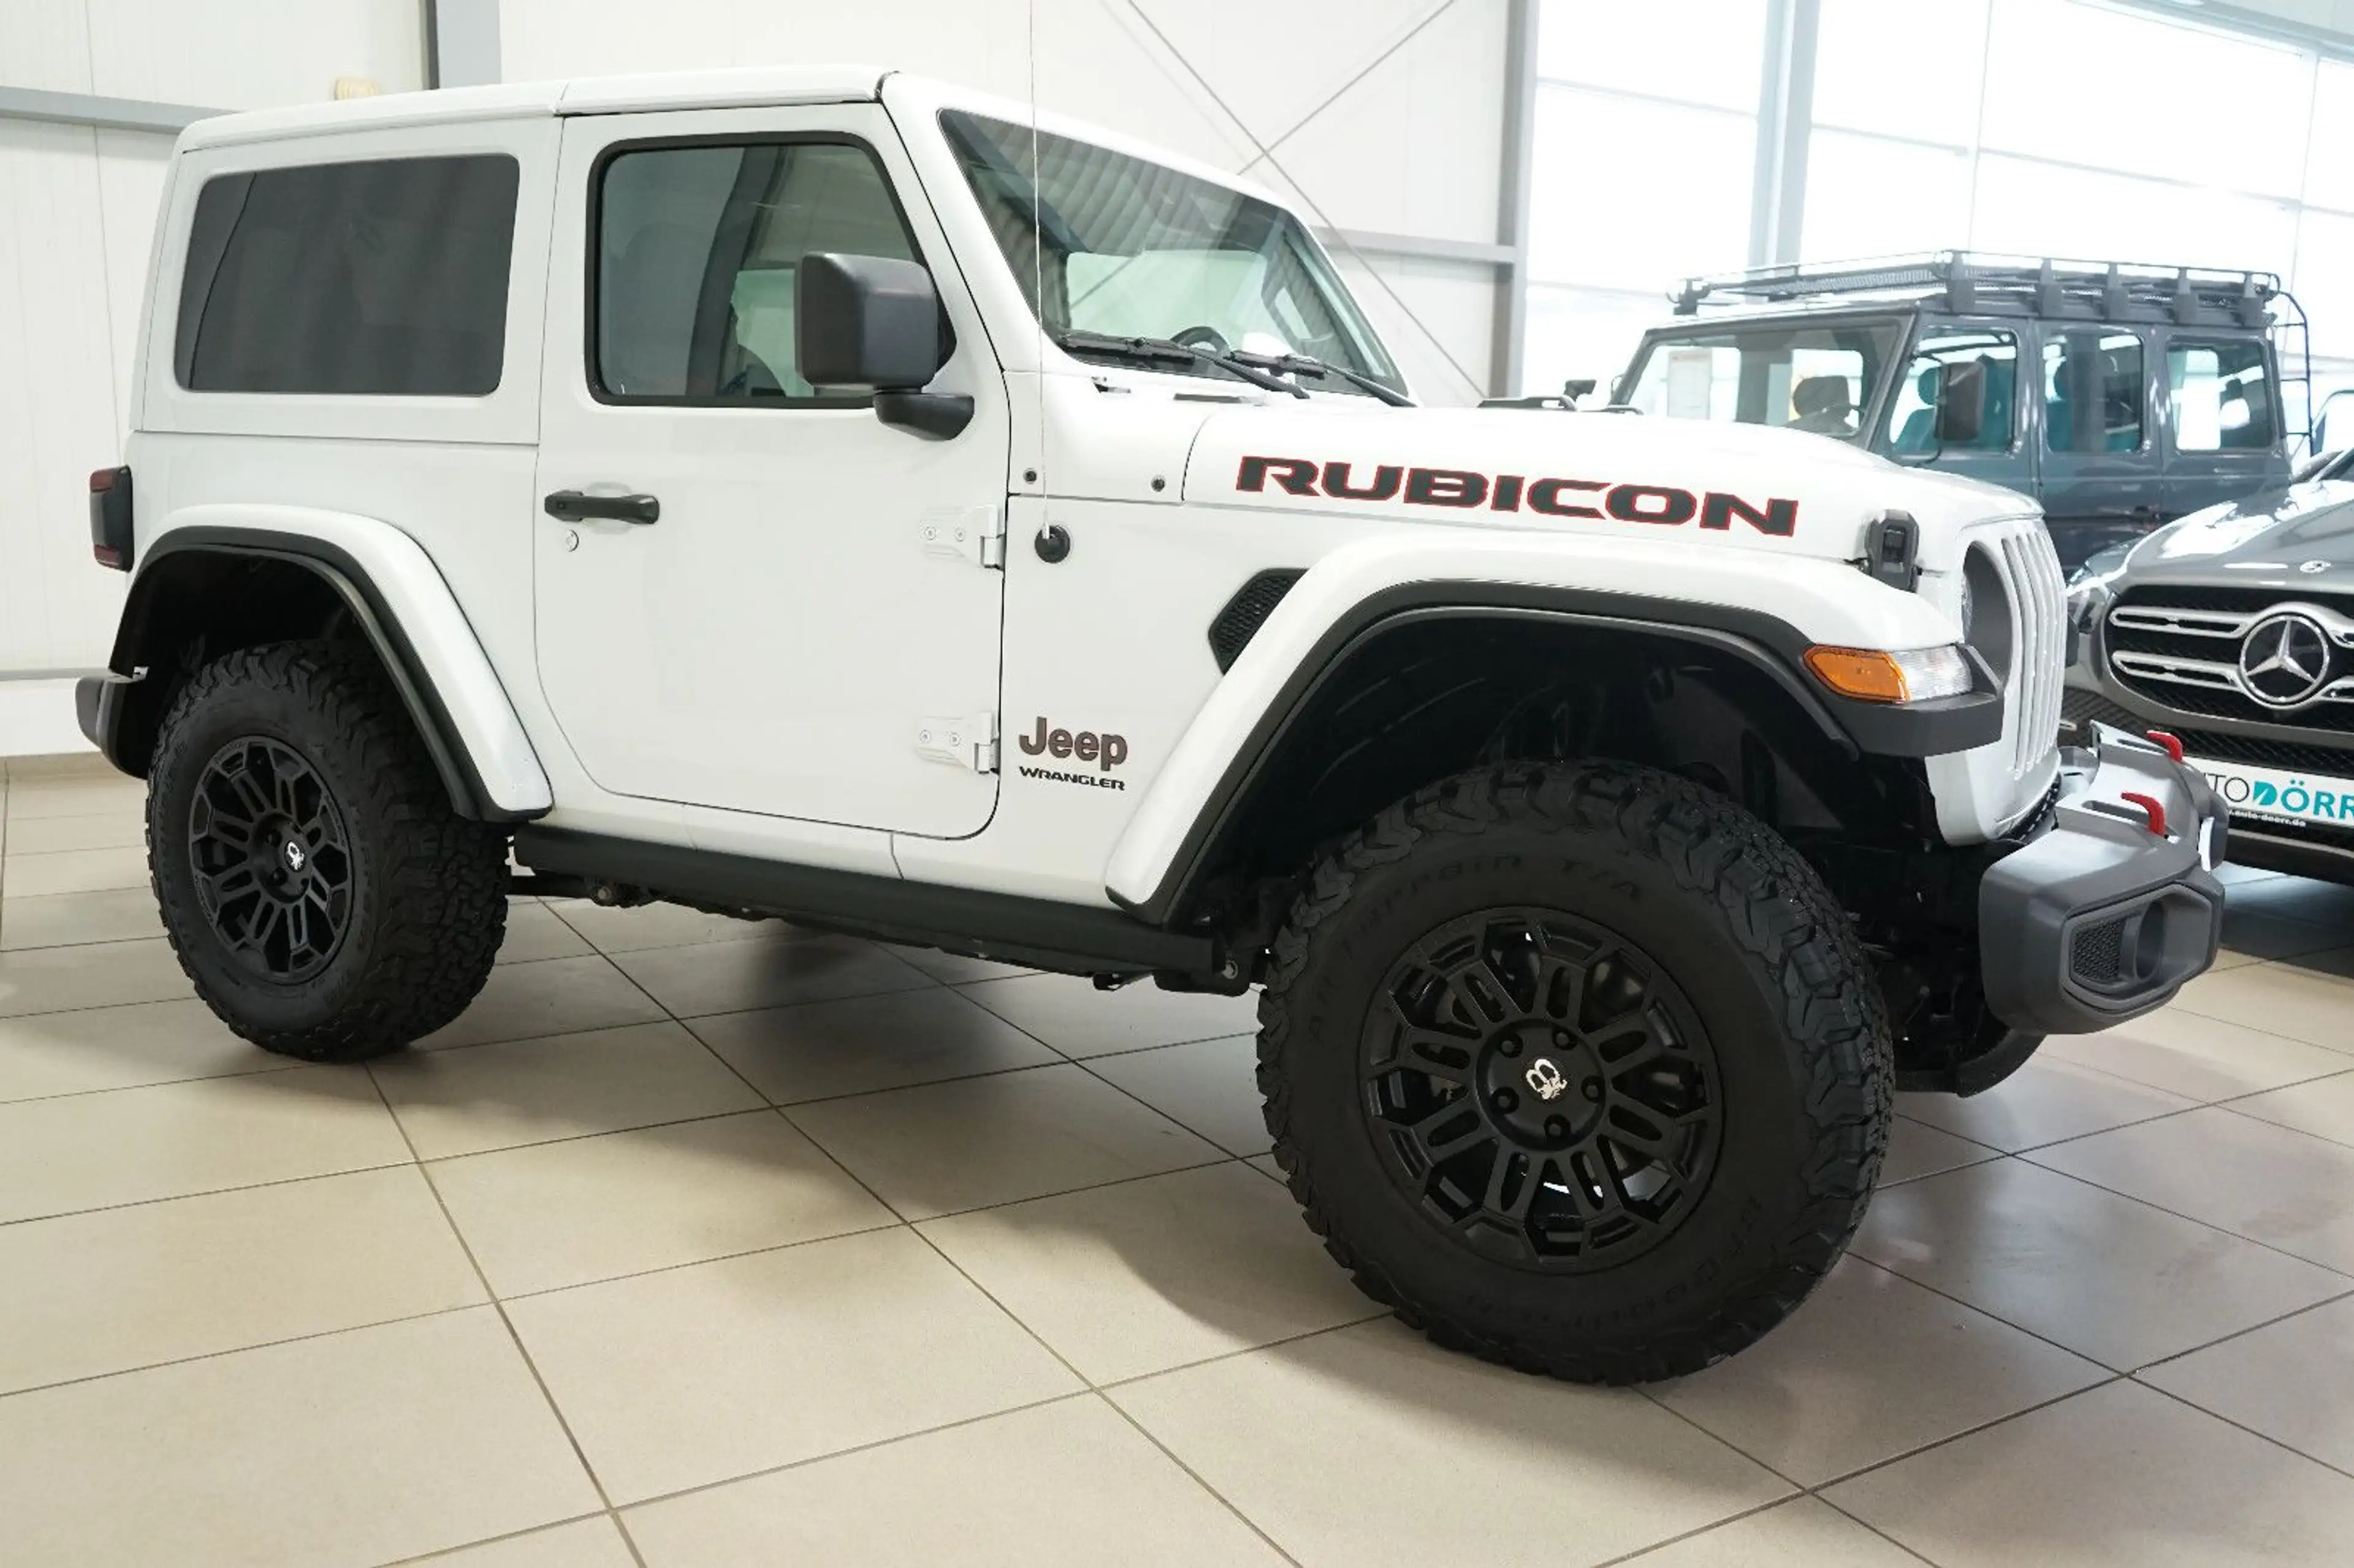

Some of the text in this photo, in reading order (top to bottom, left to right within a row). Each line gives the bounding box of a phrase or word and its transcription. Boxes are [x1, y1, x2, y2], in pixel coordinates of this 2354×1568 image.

[1235, 455, 1798, 538] RUBICON
[1019, 716, 1128, 772] Jeep
[1018, 766, 1125, 791] WRANGLER
